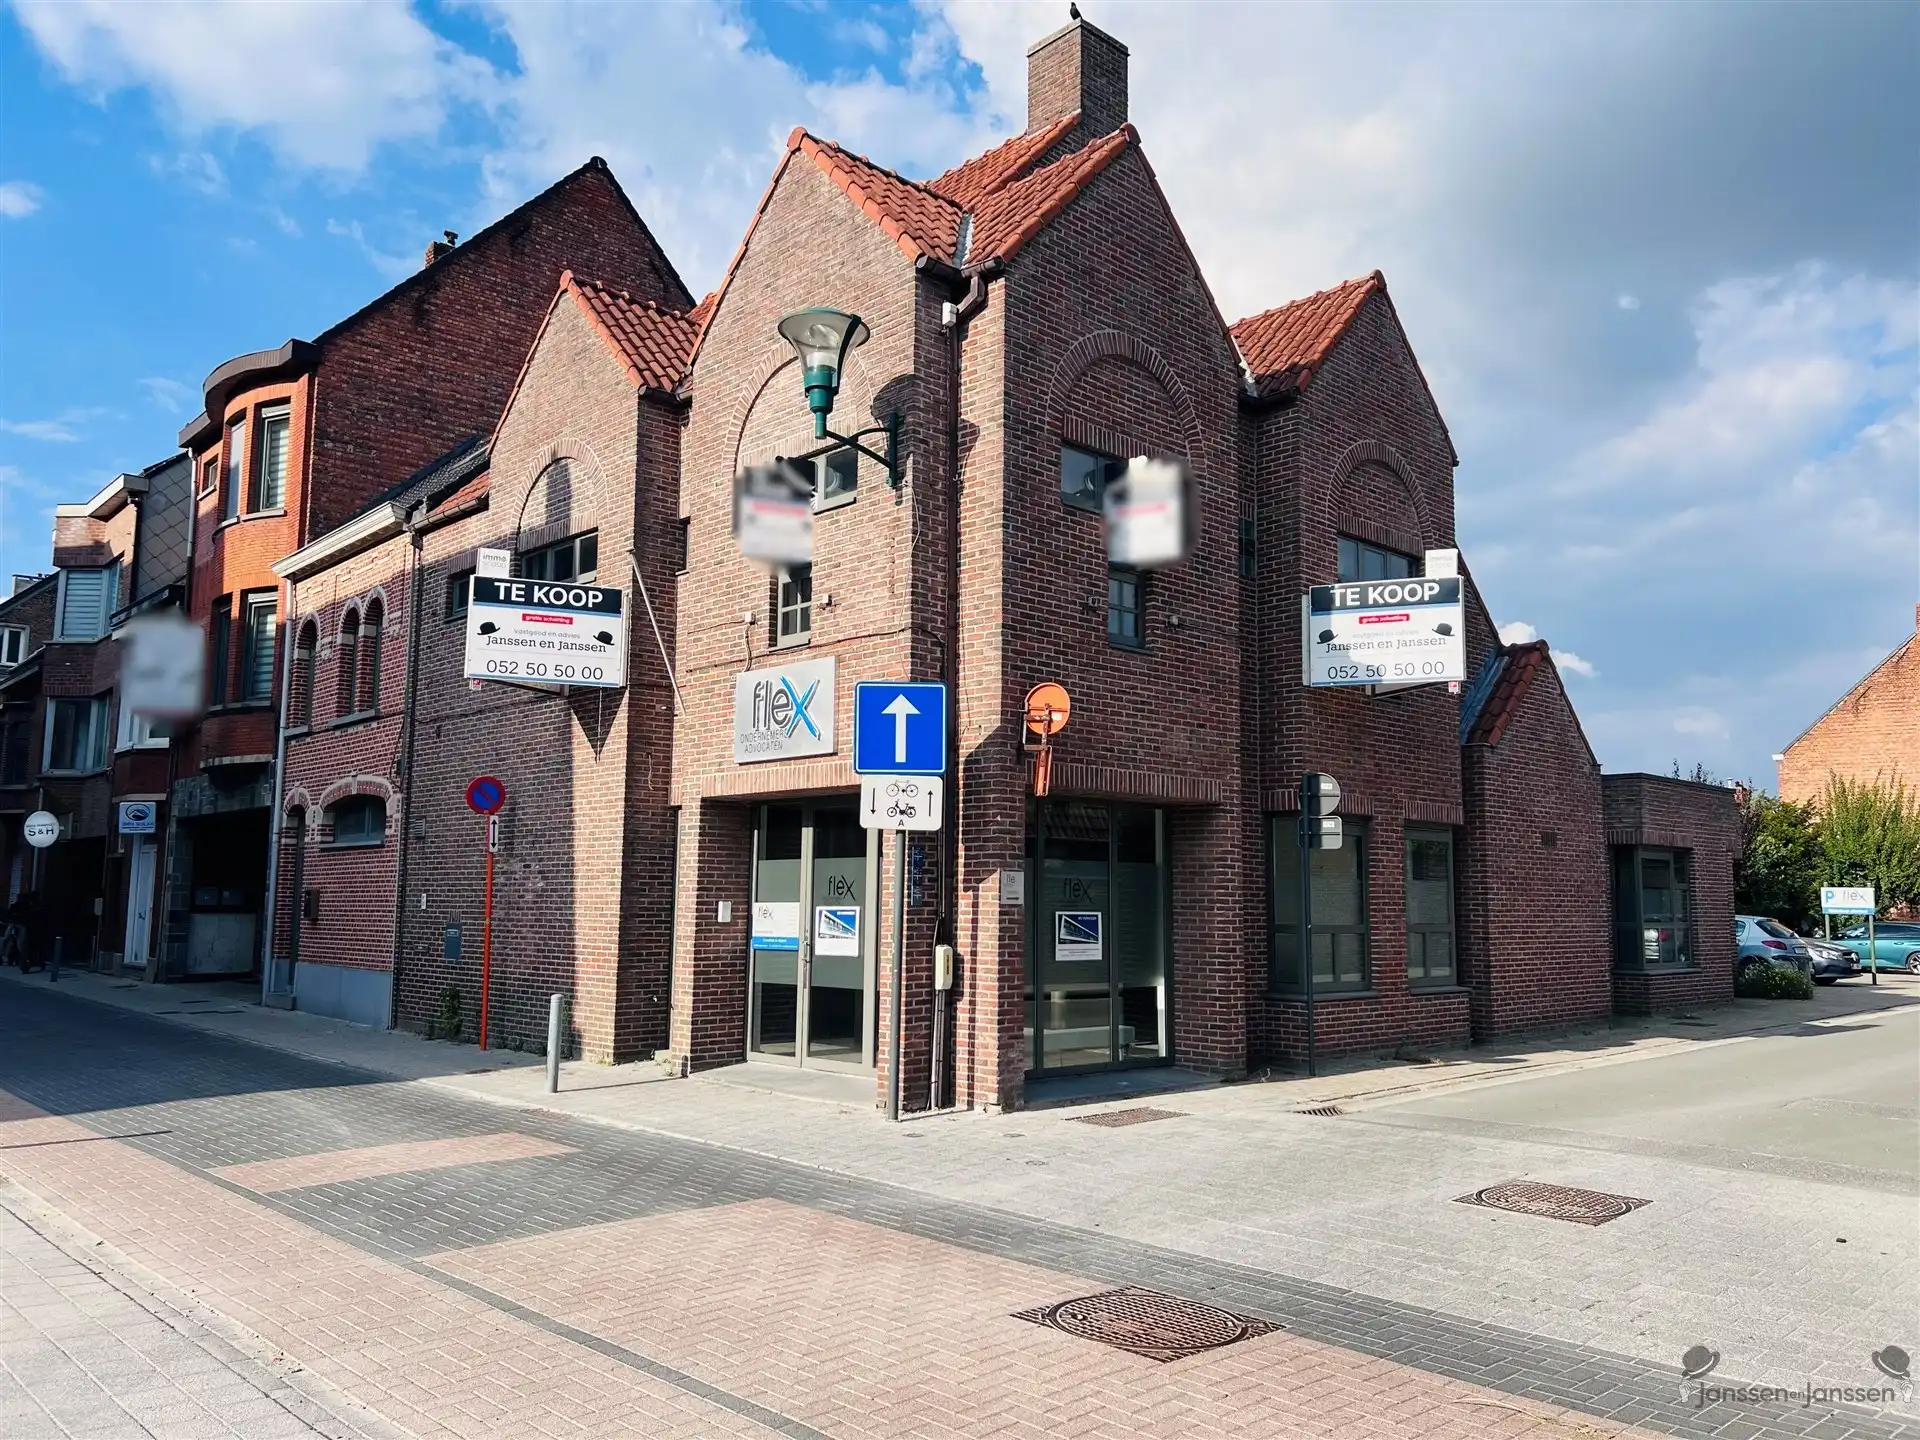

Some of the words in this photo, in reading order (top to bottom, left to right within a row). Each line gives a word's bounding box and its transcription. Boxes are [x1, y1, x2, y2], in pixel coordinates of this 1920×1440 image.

[494, 582, 526, 601] TE
[534, 585, 603, 608] KOOP
[1330, 588, 1361, 607] TE
[1368, 582, 1440, 604] KOOP
[486, 635, 536, 647] Janssen
[539, 639, 554, 648] en
[558, 641, 607, 653] Janssen
[1326, 640, 1375, 653] Janssen
[1377, 640, 1393, 650] en
[1396, 638, 1447, 650] Janssen
[486, 659, 519, 675] 052
[526, 662, 547, 677] 50
[554, 664, 575, 679] 50
[581, 666, 604, 680] 00
[1328, 665, 1359, 679] 052
[1366, 663, 1387, 677] 50
[1394, 662, 1415, 677] 50
[1422, 661, 1445, 675] 00
[744, 741, 783, 754] ADVOCATEN
[898, 819, 905, 827] A
[28, 827, 36, 837] S
[46, 826, 54, 835] H
[1825, 890, 1834, 903] P
